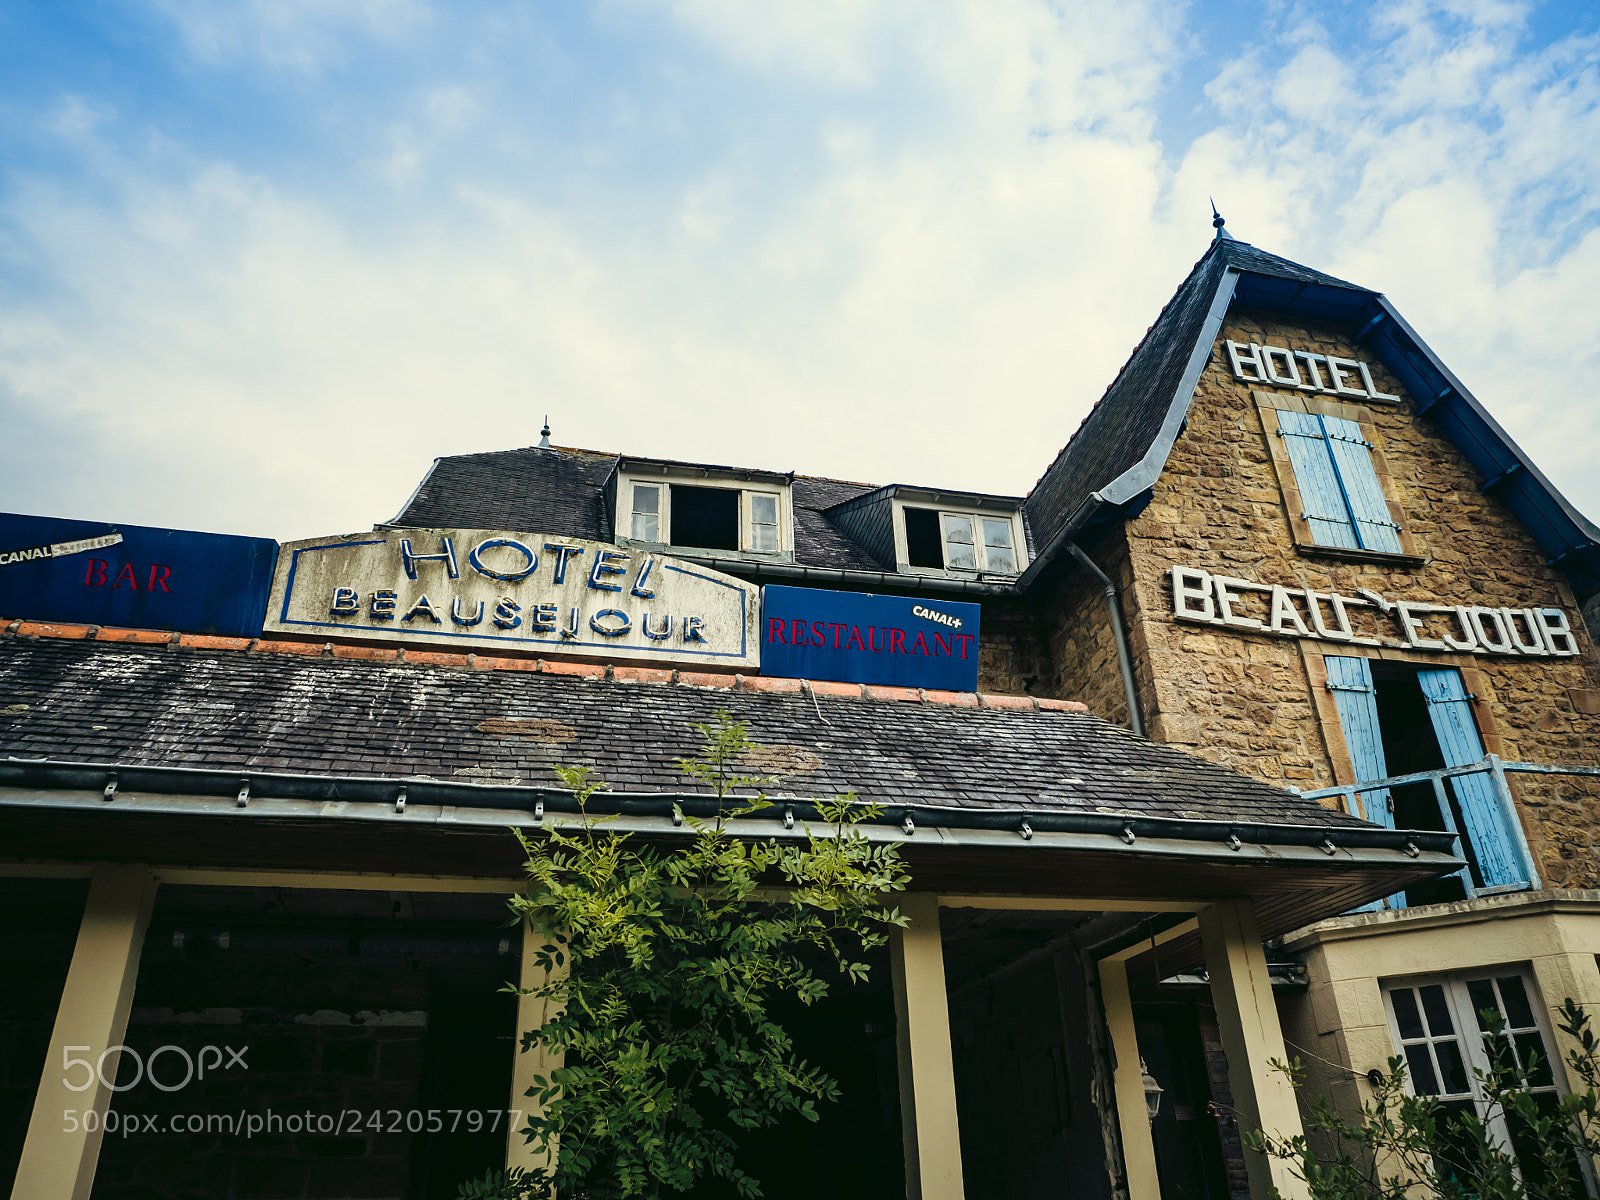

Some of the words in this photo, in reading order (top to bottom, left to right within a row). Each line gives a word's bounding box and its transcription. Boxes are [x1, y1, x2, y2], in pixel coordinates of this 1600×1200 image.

[1226, 339, 1401, 403] HOTEL
[0, 546, 52, 565] CANAL
[83, 558, 173, 593] BAR
[400, 537, 656, 599] HOTEL
[329, 586, 708, 644] BEAUSEJOUR
[912, 605, 963, 629] CANAL+
[1170, 565, 1580, 656] BEAUEJOUR
[767, 617, 975, 660] RESTAURANT
